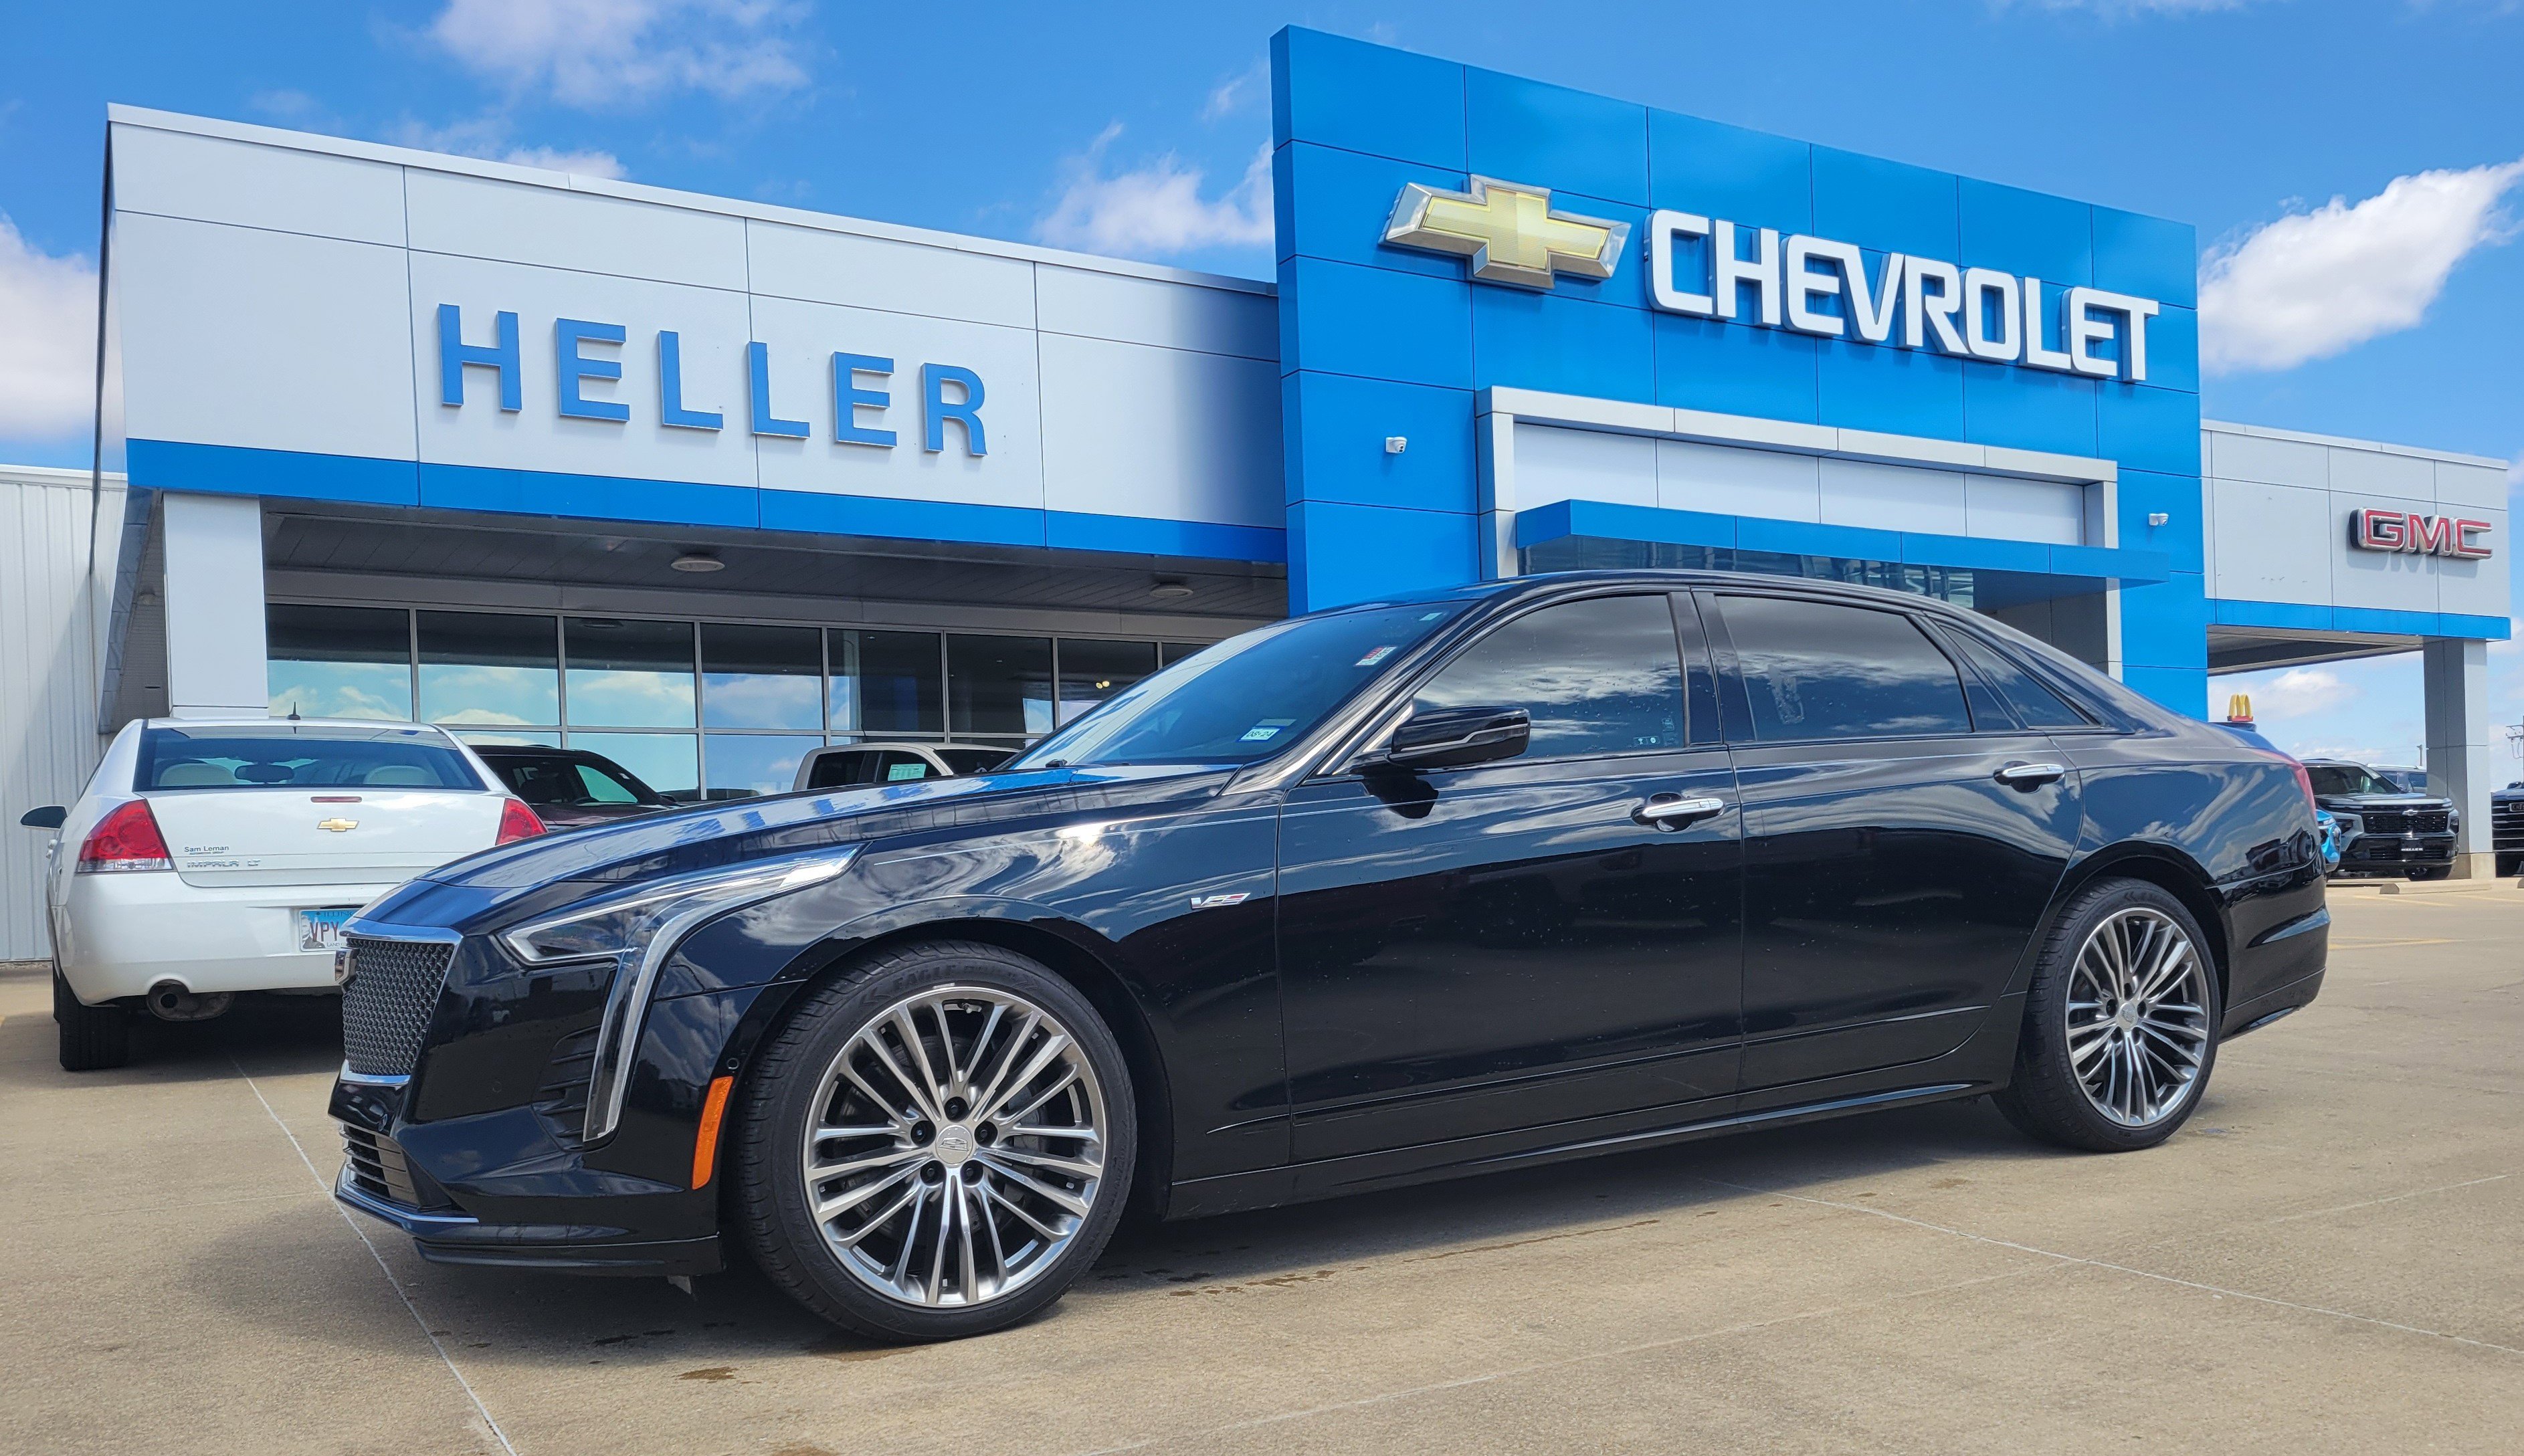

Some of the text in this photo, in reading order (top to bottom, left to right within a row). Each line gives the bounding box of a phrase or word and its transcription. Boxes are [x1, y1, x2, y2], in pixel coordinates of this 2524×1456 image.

[1645, 209, 2159, 381] CHEVROLET
[438, 303, 988, 457] HELLER
[2349, 507, 2493, 560] GMC
[187, 858, 262, 868] IMPALA LT
[310, 921, 339, 942] VPY
